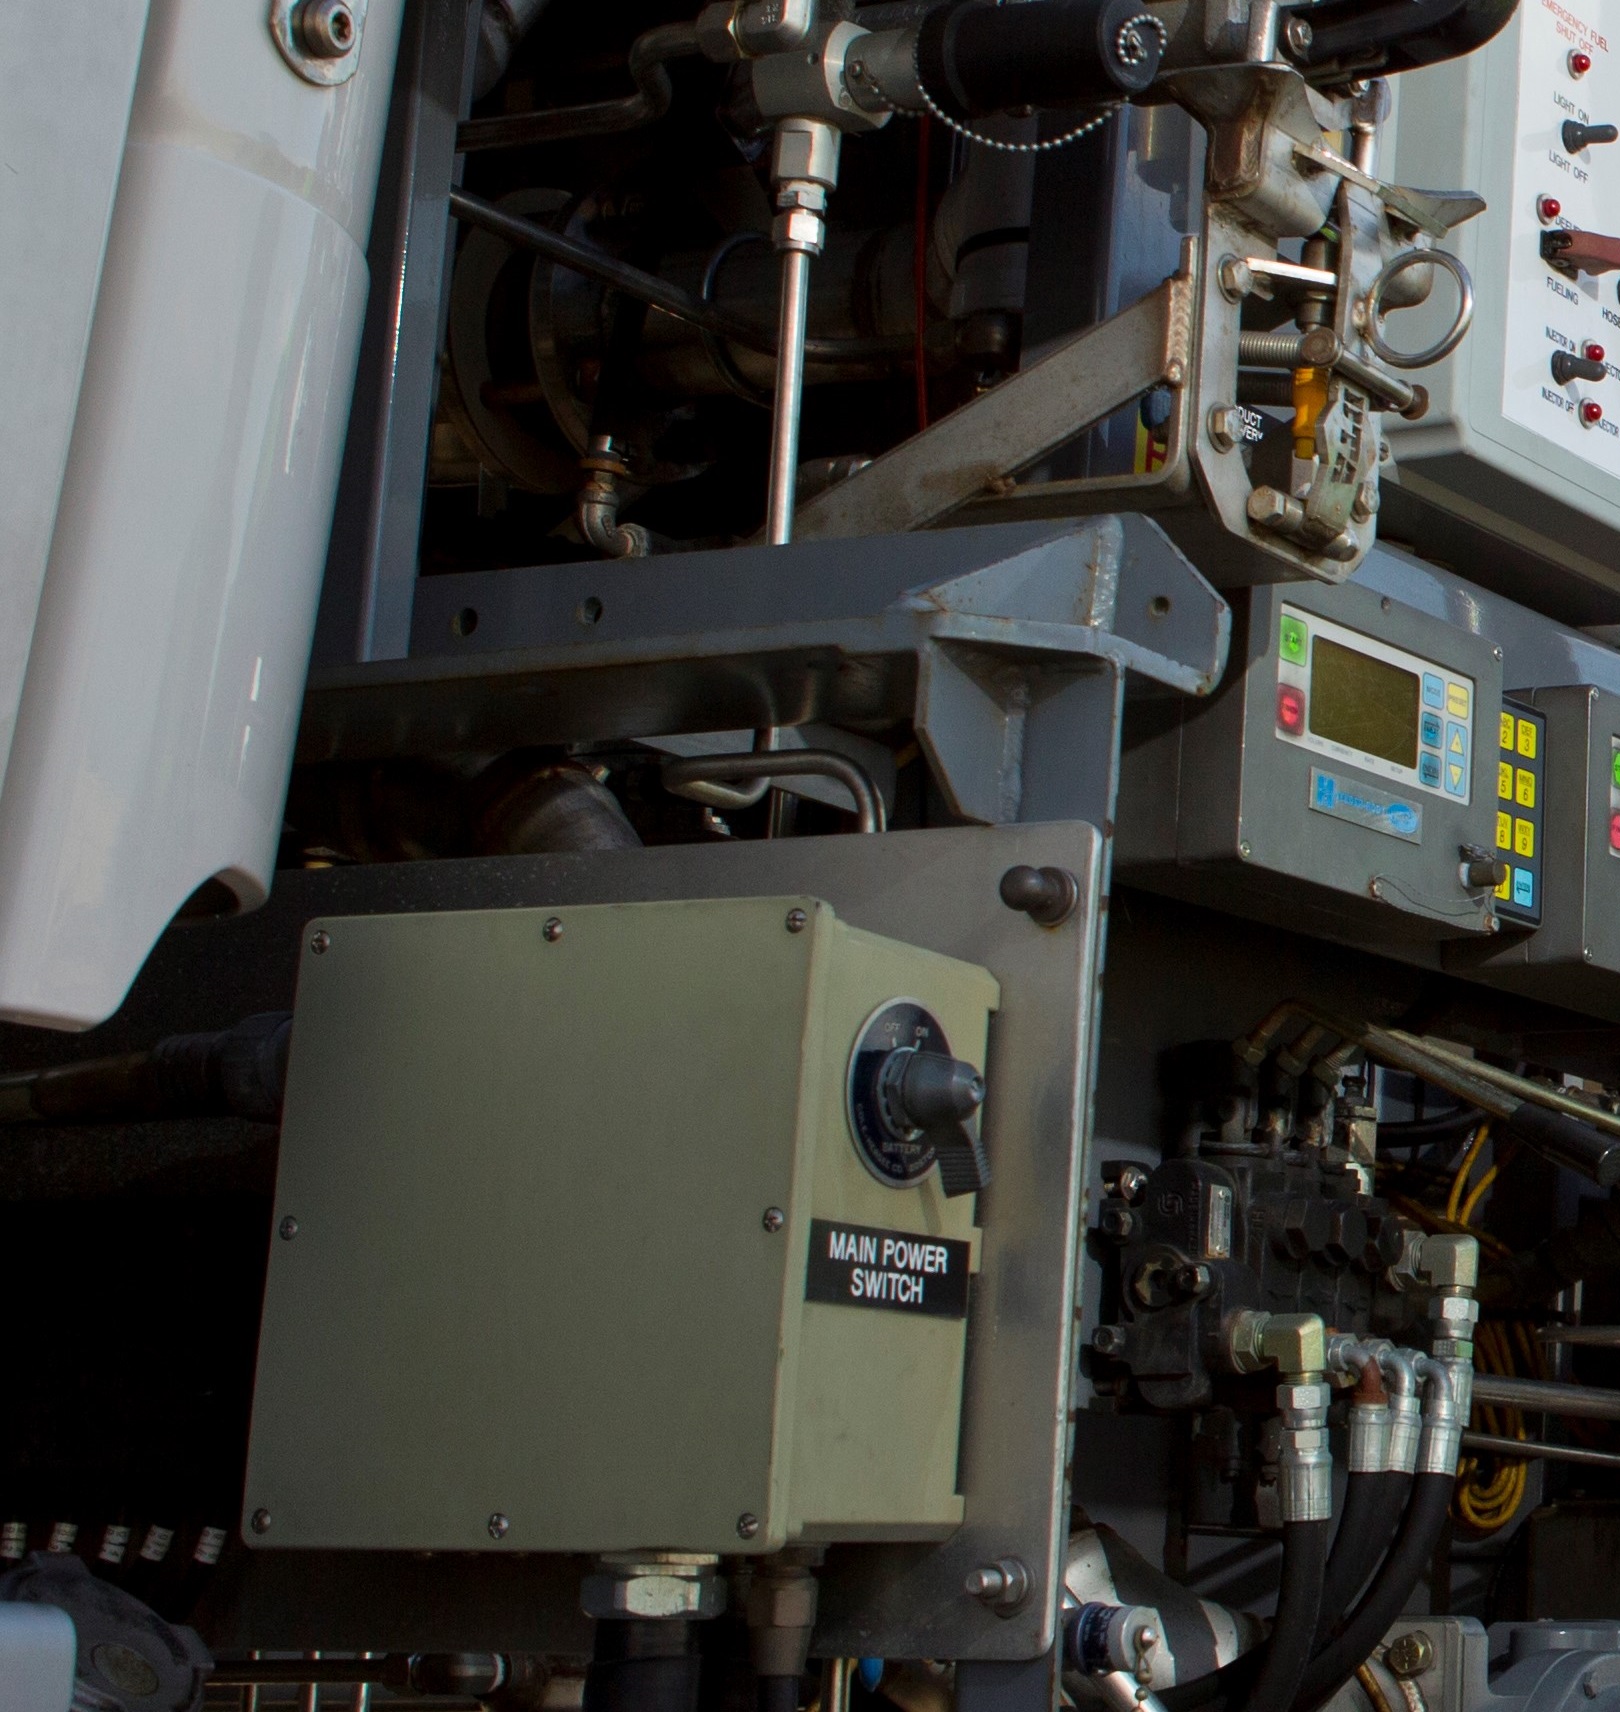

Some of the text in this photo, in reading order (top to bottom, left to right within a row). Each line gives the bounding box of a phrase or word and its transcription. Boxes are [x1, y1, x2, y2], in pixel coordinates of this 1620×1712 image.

[1556, 21, 1593, 54] SHUT OFF
[1590, 30, 1608, 53] FUEL
[1553, 91, 1589, 125] LIGHT ON
[1549, 149, 1589, 184] LIGHT OFF
[1546, 276, 1579, 305] FUELING
[1569, 338, 1576, 354] ON
[1565, 400, 1575, 415] OFF
[1502, 730, 1508, 744] 2
[1524, 738, 1530, 752] 3
[1501, 780, 1507, 794] 5
[1523, 788, 1529, 802] 6
[1500, 829, 1506, 843] 8
[1521, 837, 1528, 851] 9
[884, 1022, 928, 1037] OFF ON
[882, 1142, 922, 1153] BATTERY
[829, 1230, 948, 1274] MAIN POWER
[850, 1267, 924, 1304] SWITCH
